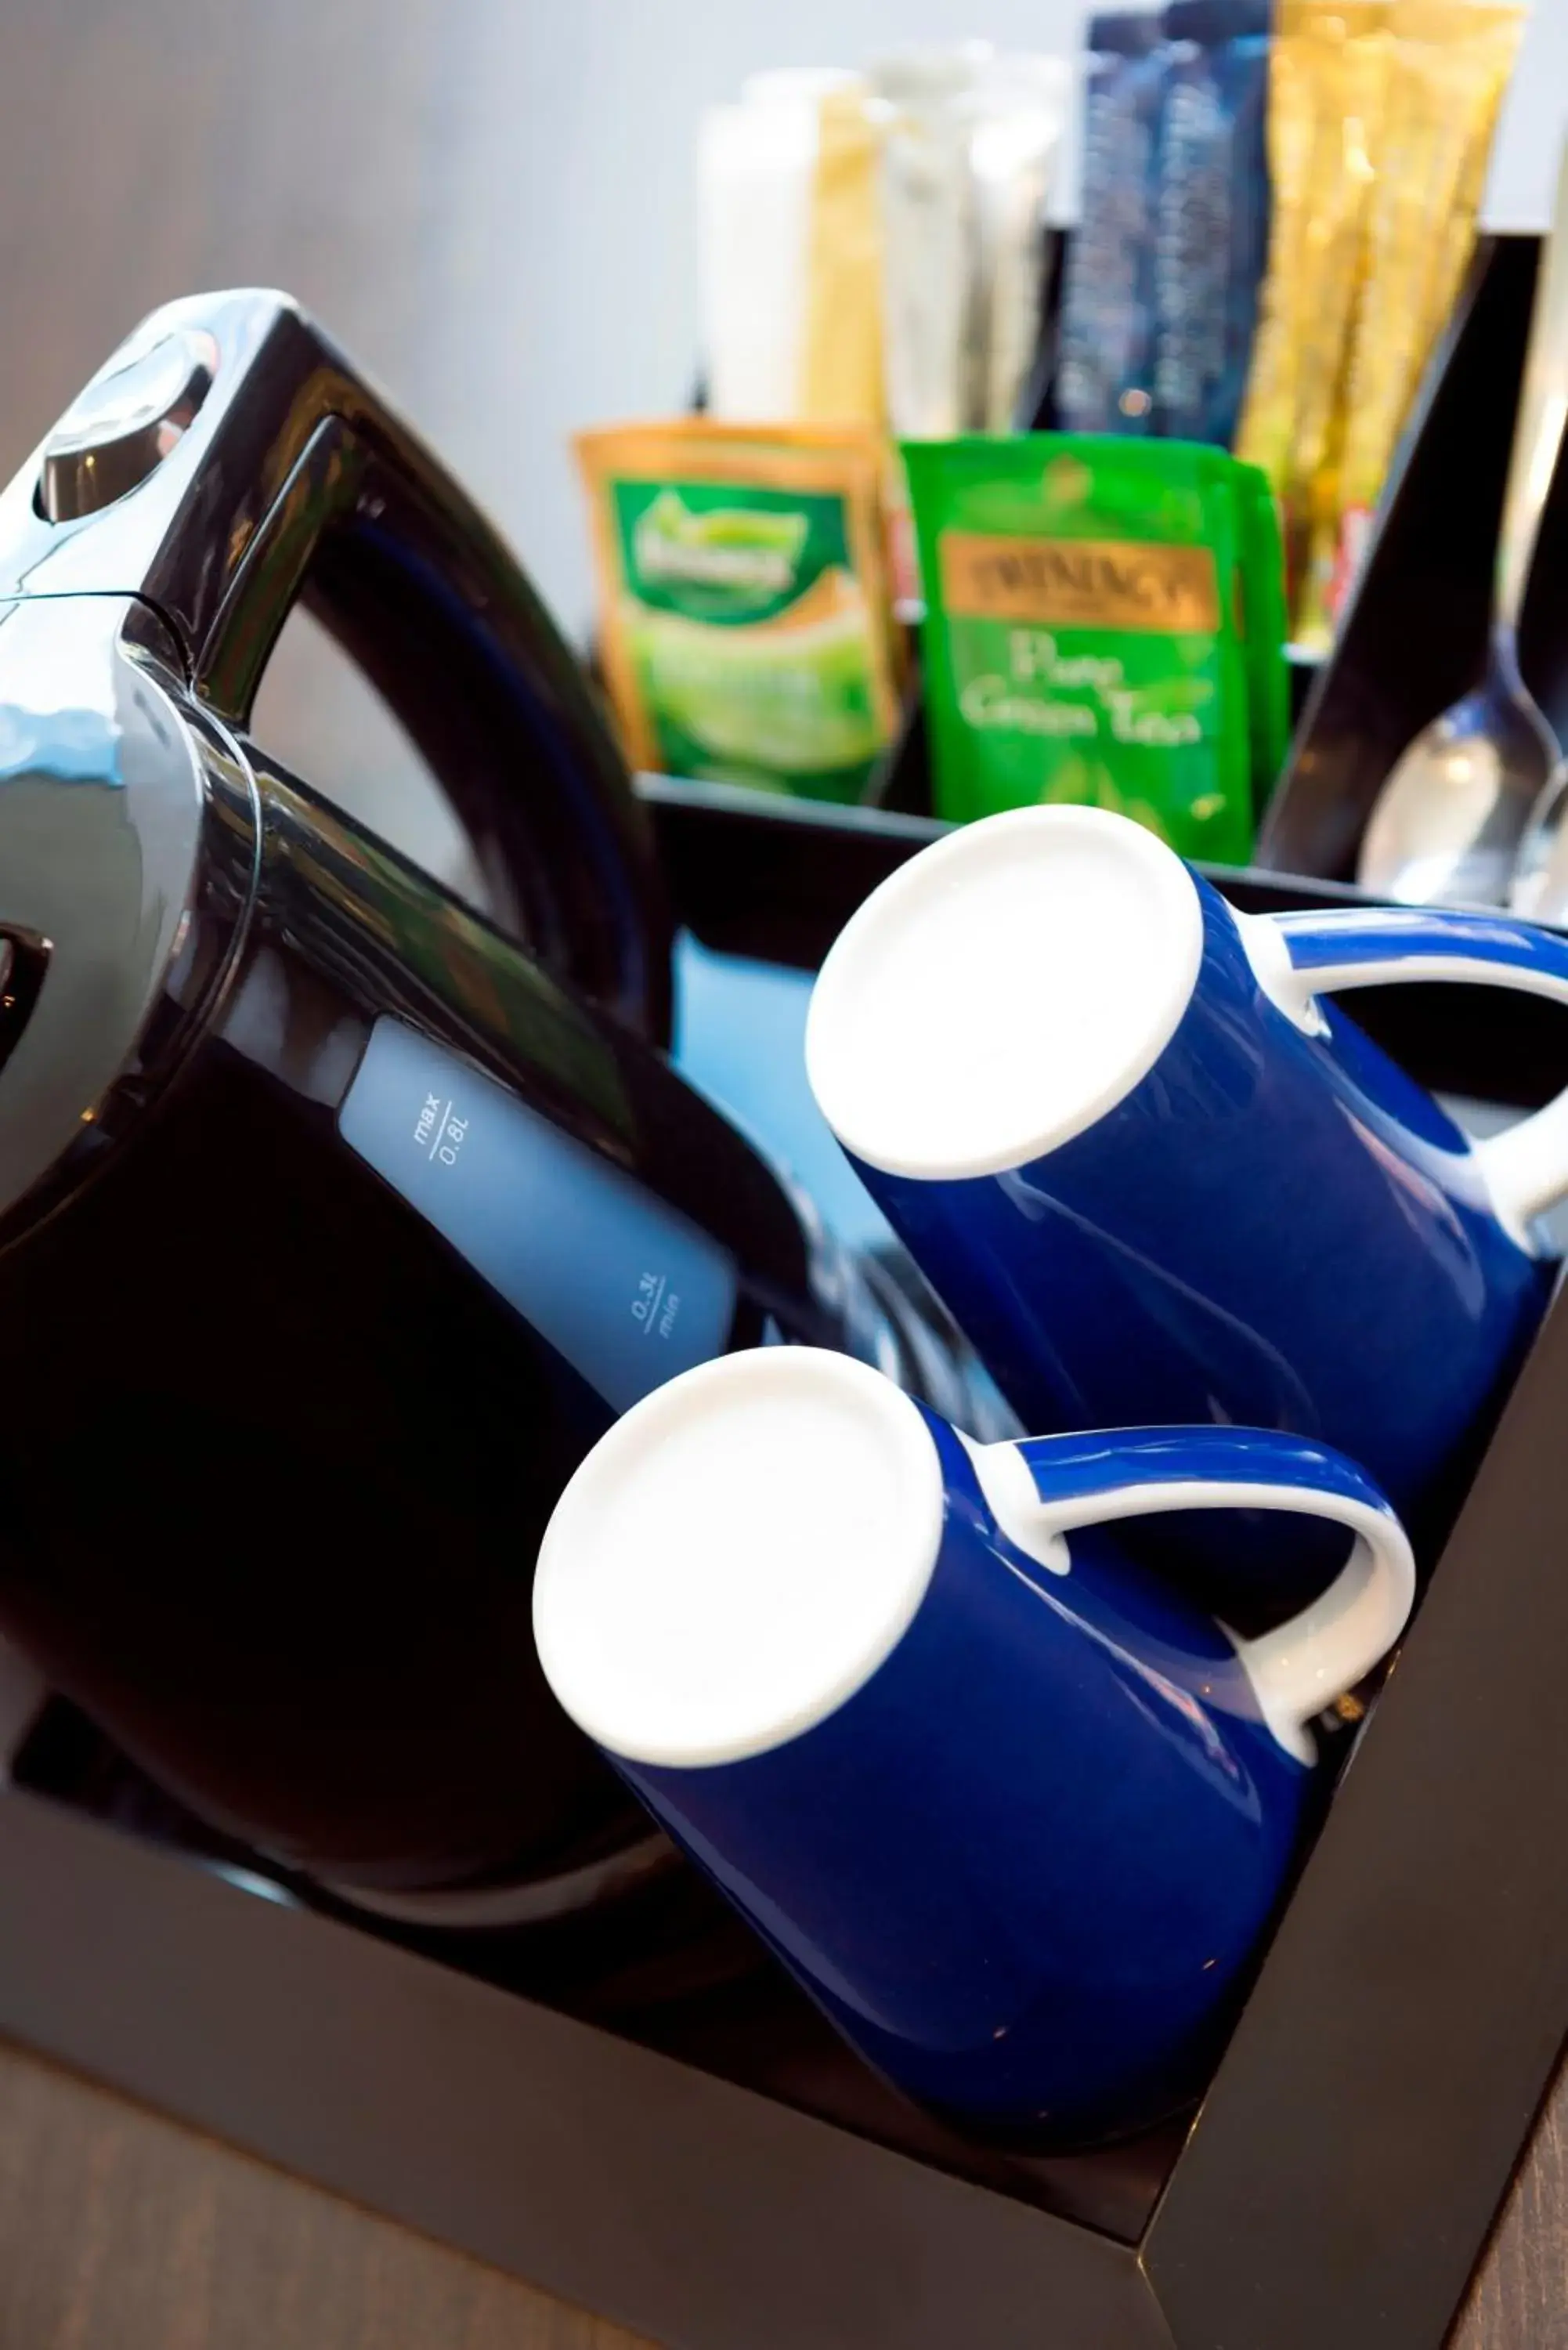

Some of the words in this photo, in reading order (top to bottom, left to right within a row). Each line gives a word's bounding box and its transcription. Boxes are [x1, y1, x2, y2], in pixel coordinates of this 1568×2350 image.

[1010, 628, 1125, 686] Pure
[959, 674, 1098, 736] Green
[1105, 688, 1202, 745] Tea
[414, 1092, 441, 1145] max
[439, 1116, 469, 1166] 0.8L
[630, 1272, 659, 1321] 0.3L
[659, 1293, 681, 1340] min
